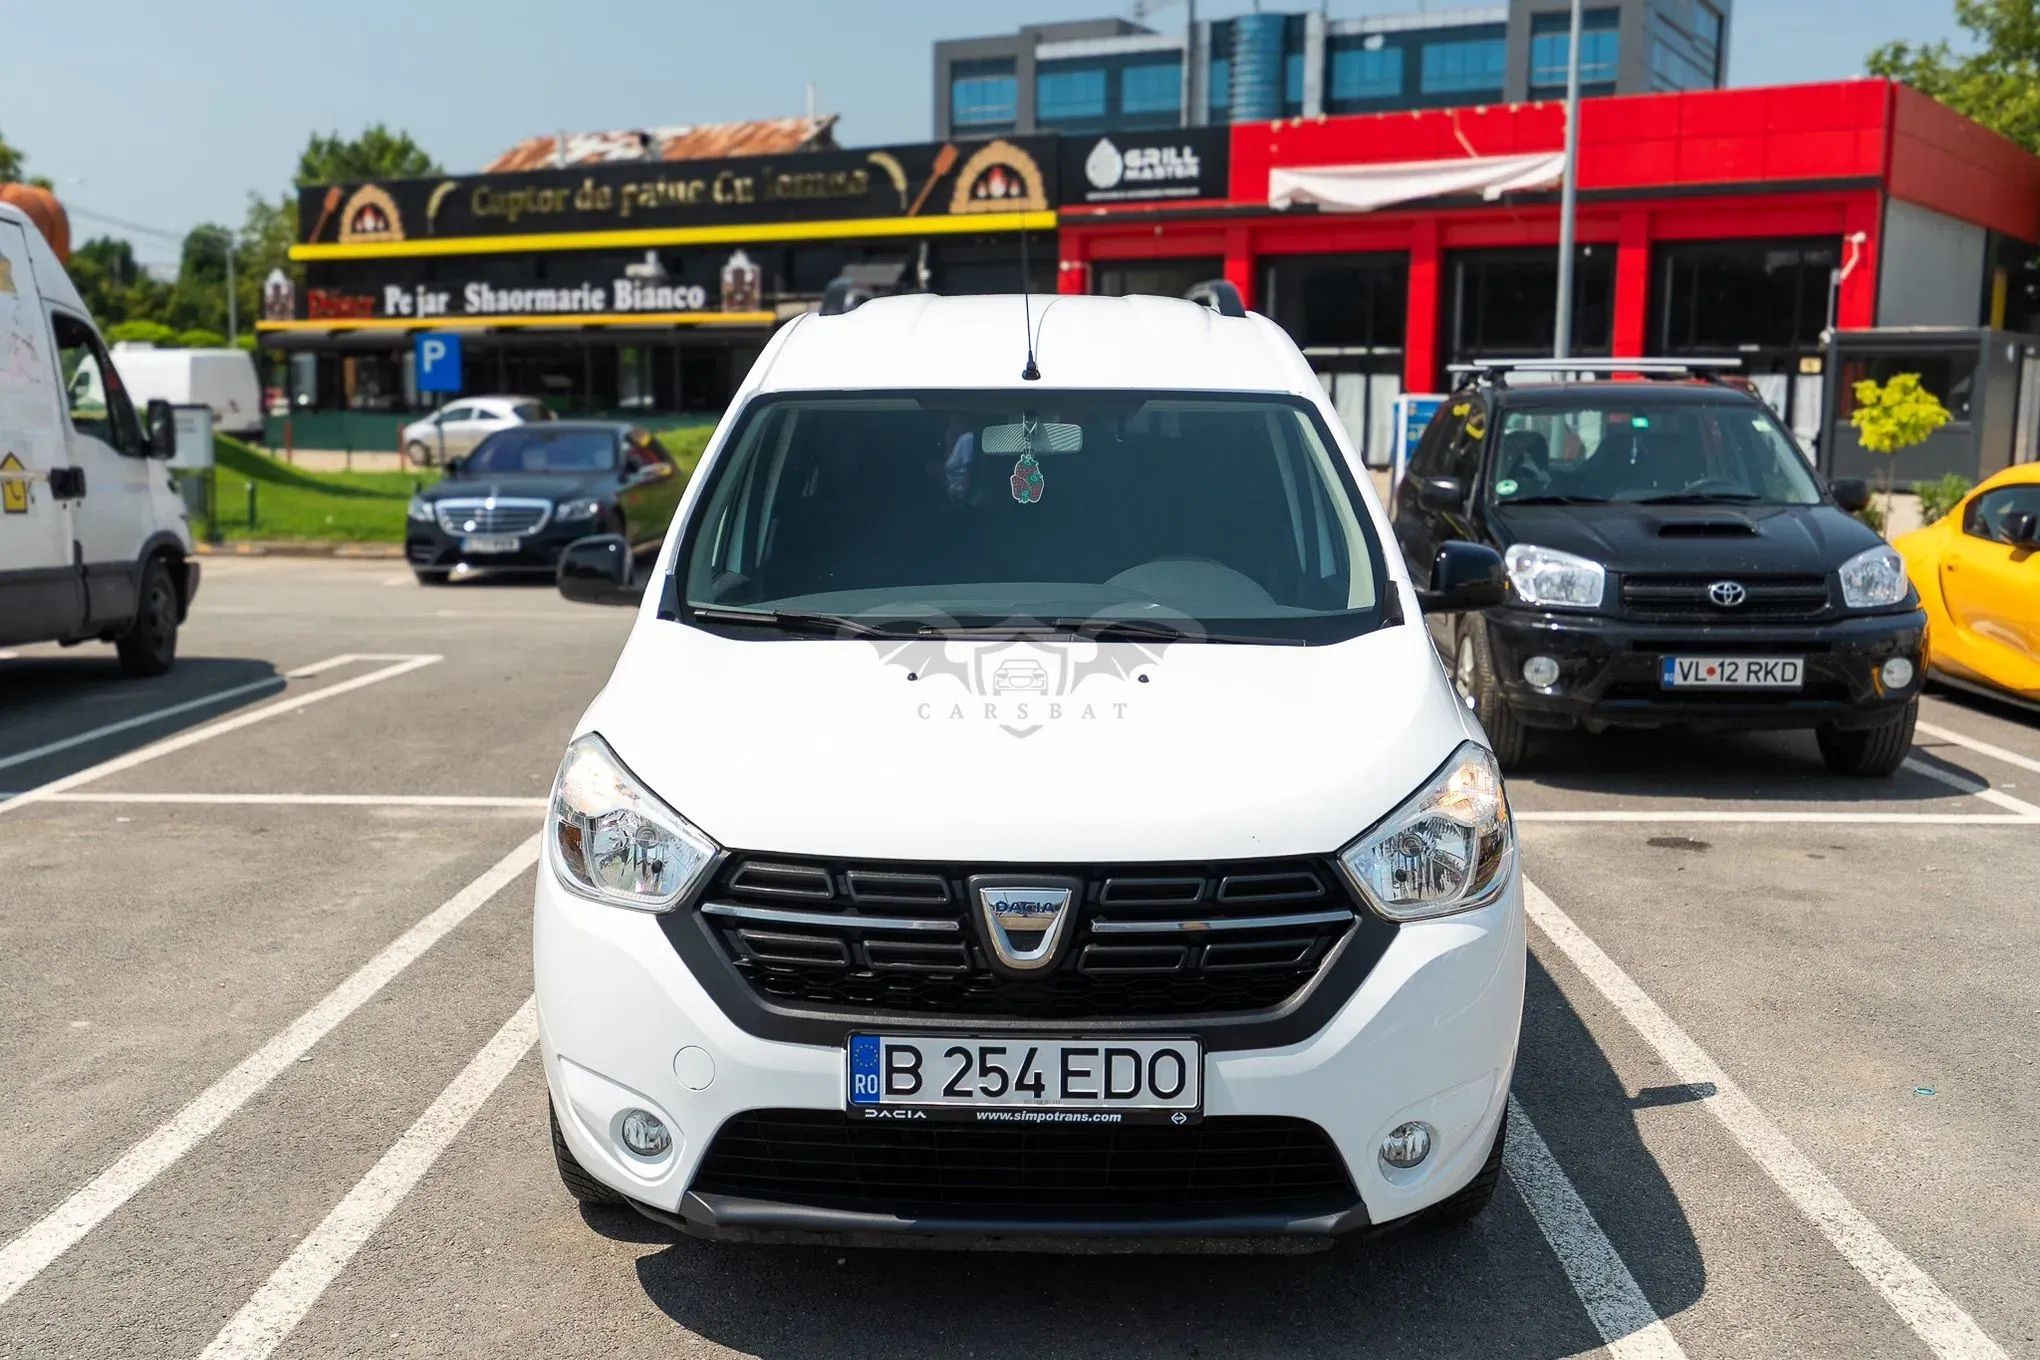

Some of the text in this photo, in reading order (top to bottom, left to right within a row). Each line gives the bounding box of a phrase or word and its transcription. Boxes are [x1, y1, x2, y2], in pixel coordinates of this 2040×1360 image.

[1123, 145, 1199, 167] GRILL
[1123, 163, 1199, 180] MASTER
[383, 283, 412, 316] Pe
[415, 284, 450, 318] jar
[463, 281, 607, 314] Shaormarie
[612, 278, 706, 312] Bianco
[422, 339, 447, 374] P
[1678, 660, 1798, 683] VL 12 RKD
[885, 1044, 1187, 1100] B 254 EDO
[855, 1074, 878, 1094] RO
[864, 1108, 928, 1119] DACIA
[976, 1110, 1122, 1124] www.simpotrans.com
